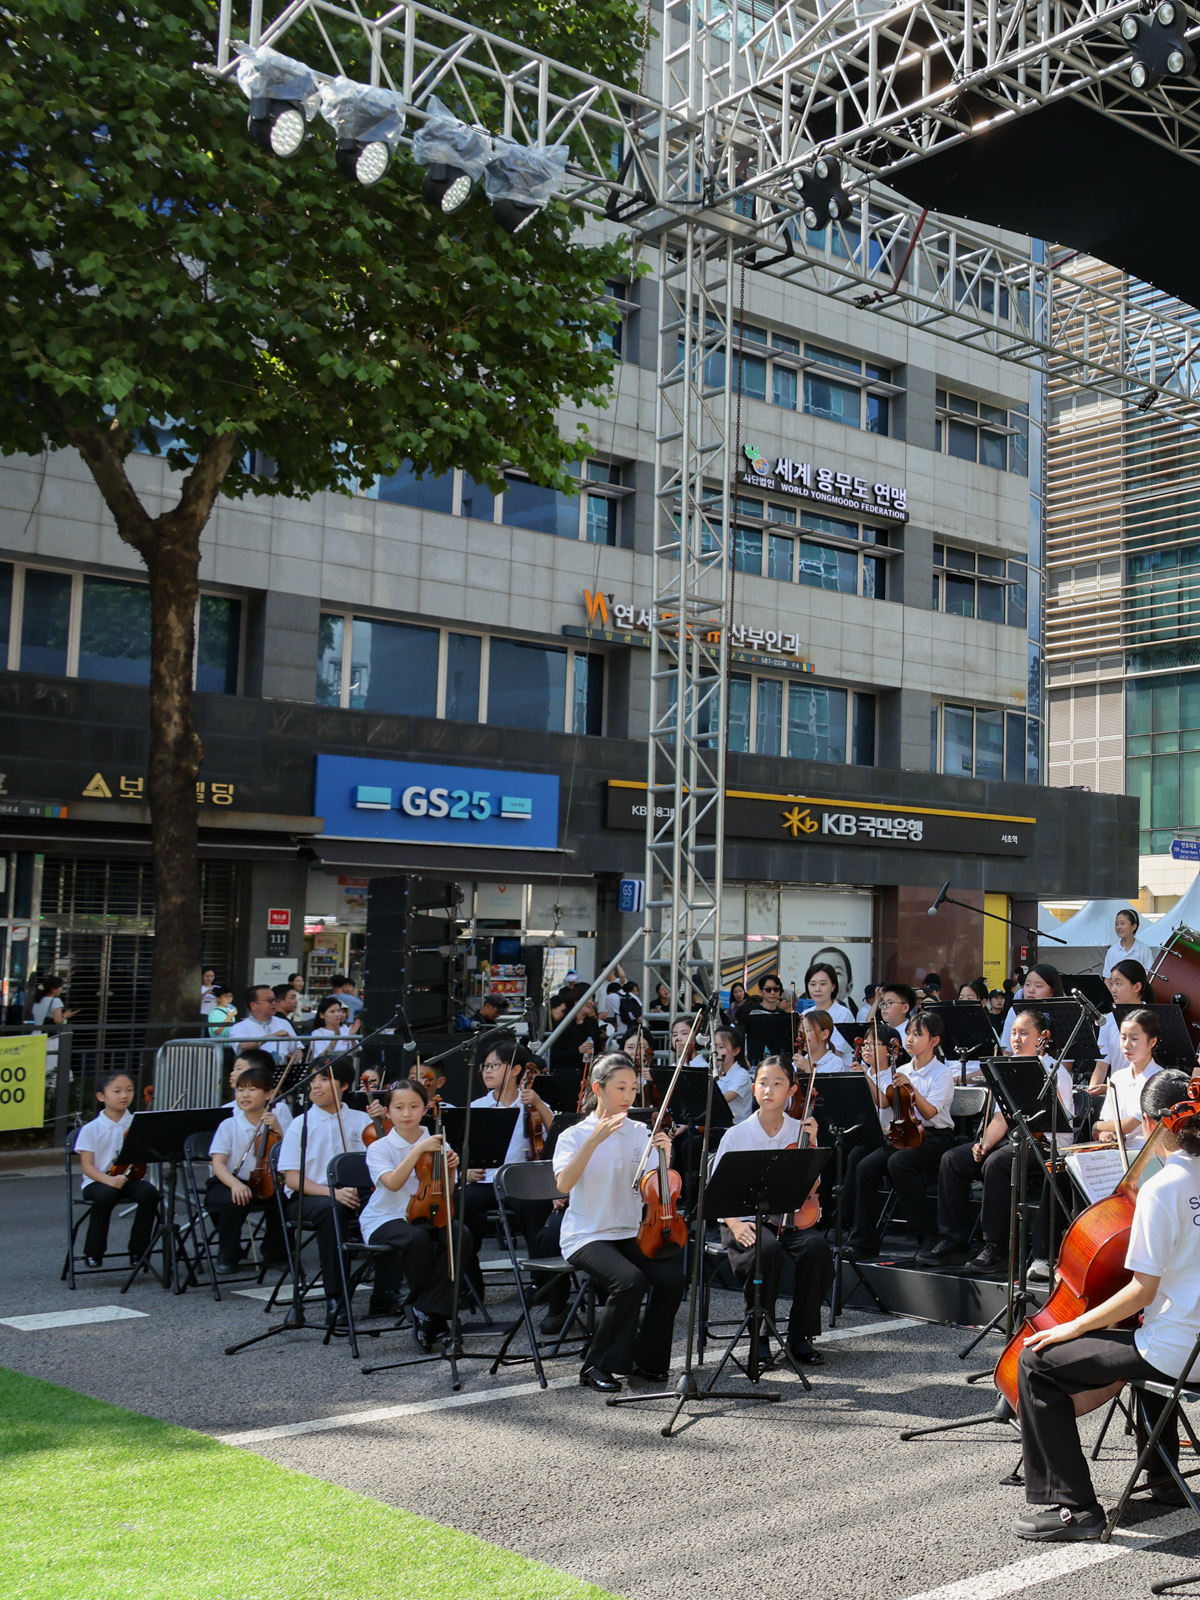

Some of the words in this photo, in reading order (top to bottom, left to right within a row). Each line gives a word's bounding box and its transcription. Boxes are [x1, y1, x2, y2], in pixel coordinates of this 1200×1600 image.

[743, 473, 775, 489] 사단법인
[775, 457, 811, 487] 세계
[817, 467, 869, 499] 용무도
[873, 483, 907, 510] 연맹
[781, 483, 809, 497] WORLD
[810, 490, 860, 509] YONGMOODO
[861, 503, 905, 520] FEDERATION
[402, 786, 492, 820] GS25
[822, 812, 923, 842] KB국민은행
[622, 884, 633, 896] GS
[622, 896, 632, 908] 25
[270, 934, 287, 944] 111
